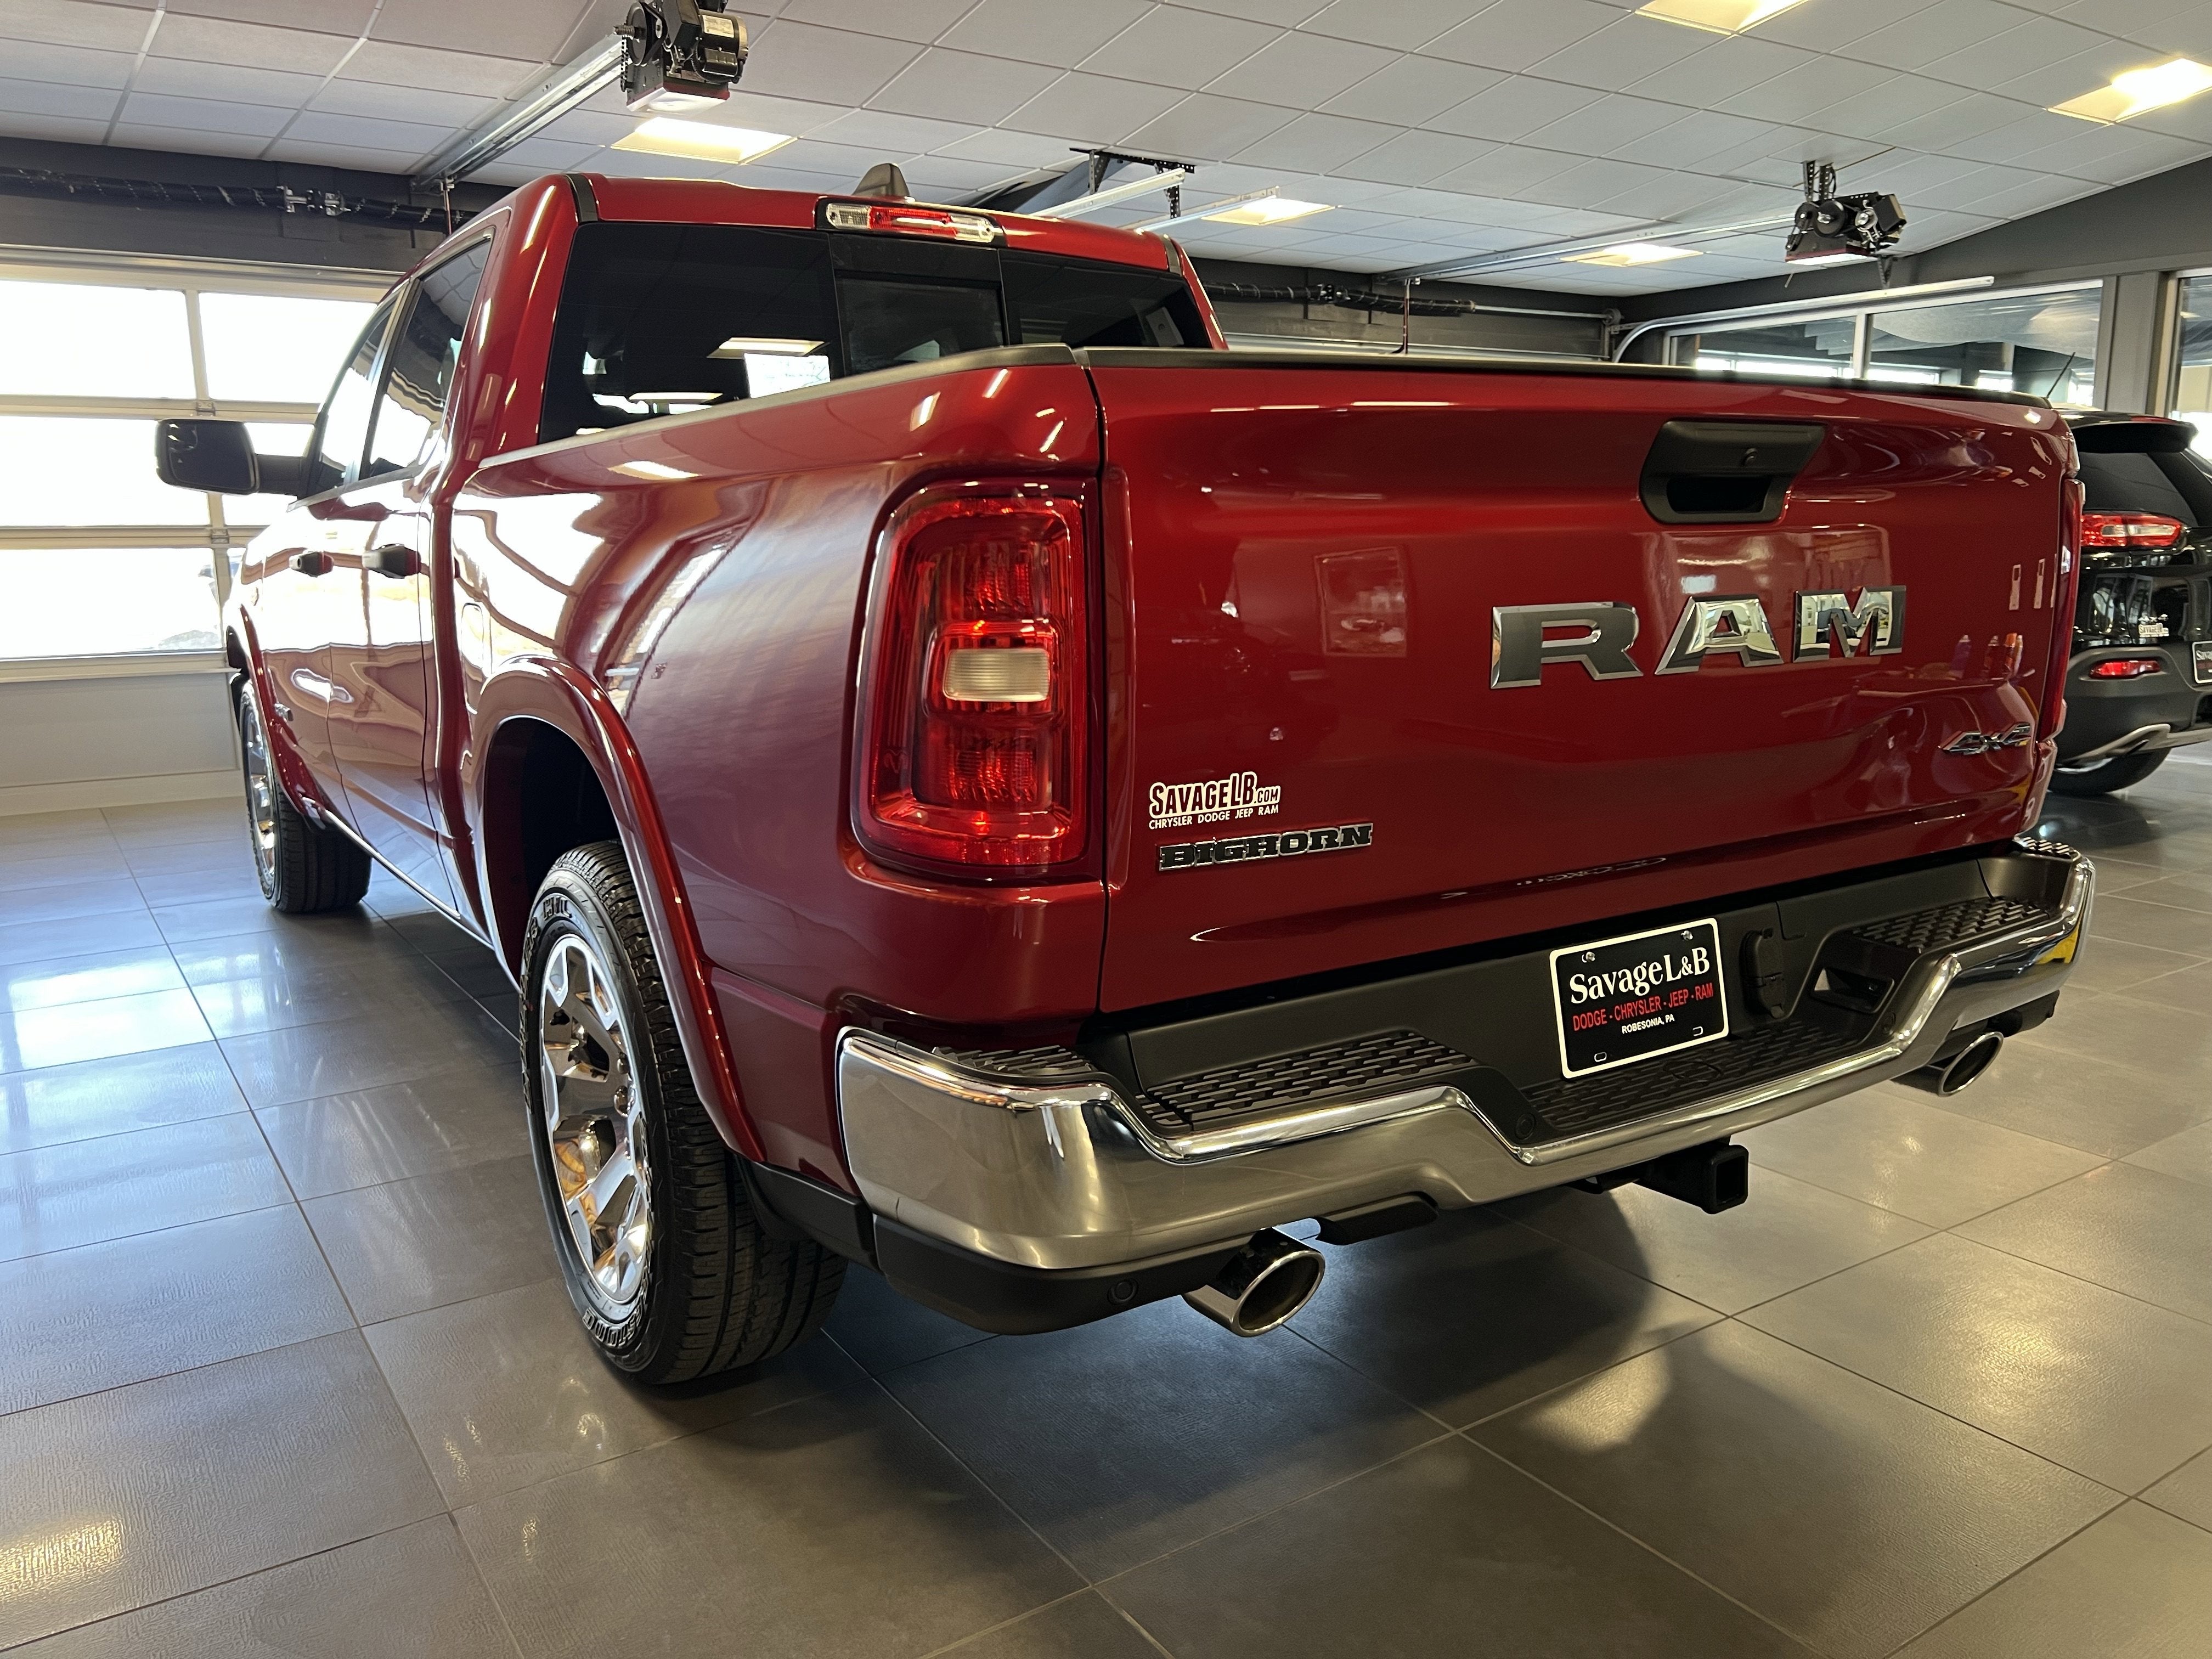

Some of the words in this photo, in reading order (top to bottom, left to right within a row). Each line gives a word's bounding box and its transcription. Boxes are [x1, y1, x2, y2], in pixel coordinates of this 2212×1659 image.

[1490, 585, 1906, 689] RAM
[1149, 816, 1193, 830] CHRYSLER
[1198, 811, 1230, 823] DODGE
[1234, 808, 1254, 819] JEEP
[1258, 805, 1279, 815] RAM
[1159, 823, 1373, 871] BIGHORN
[1573, 1008, 1607, 1031] DODGE
[1614, 996, 1662, 1021] CHRYSLER
[1668, 989, 1689, 1007] JEEP
[1695, 982, 1714, 1001] RAM
[1621, 1018, 1664, 1034] ROBESONIA,
[1664, 1013, 1675, 1023] PA
